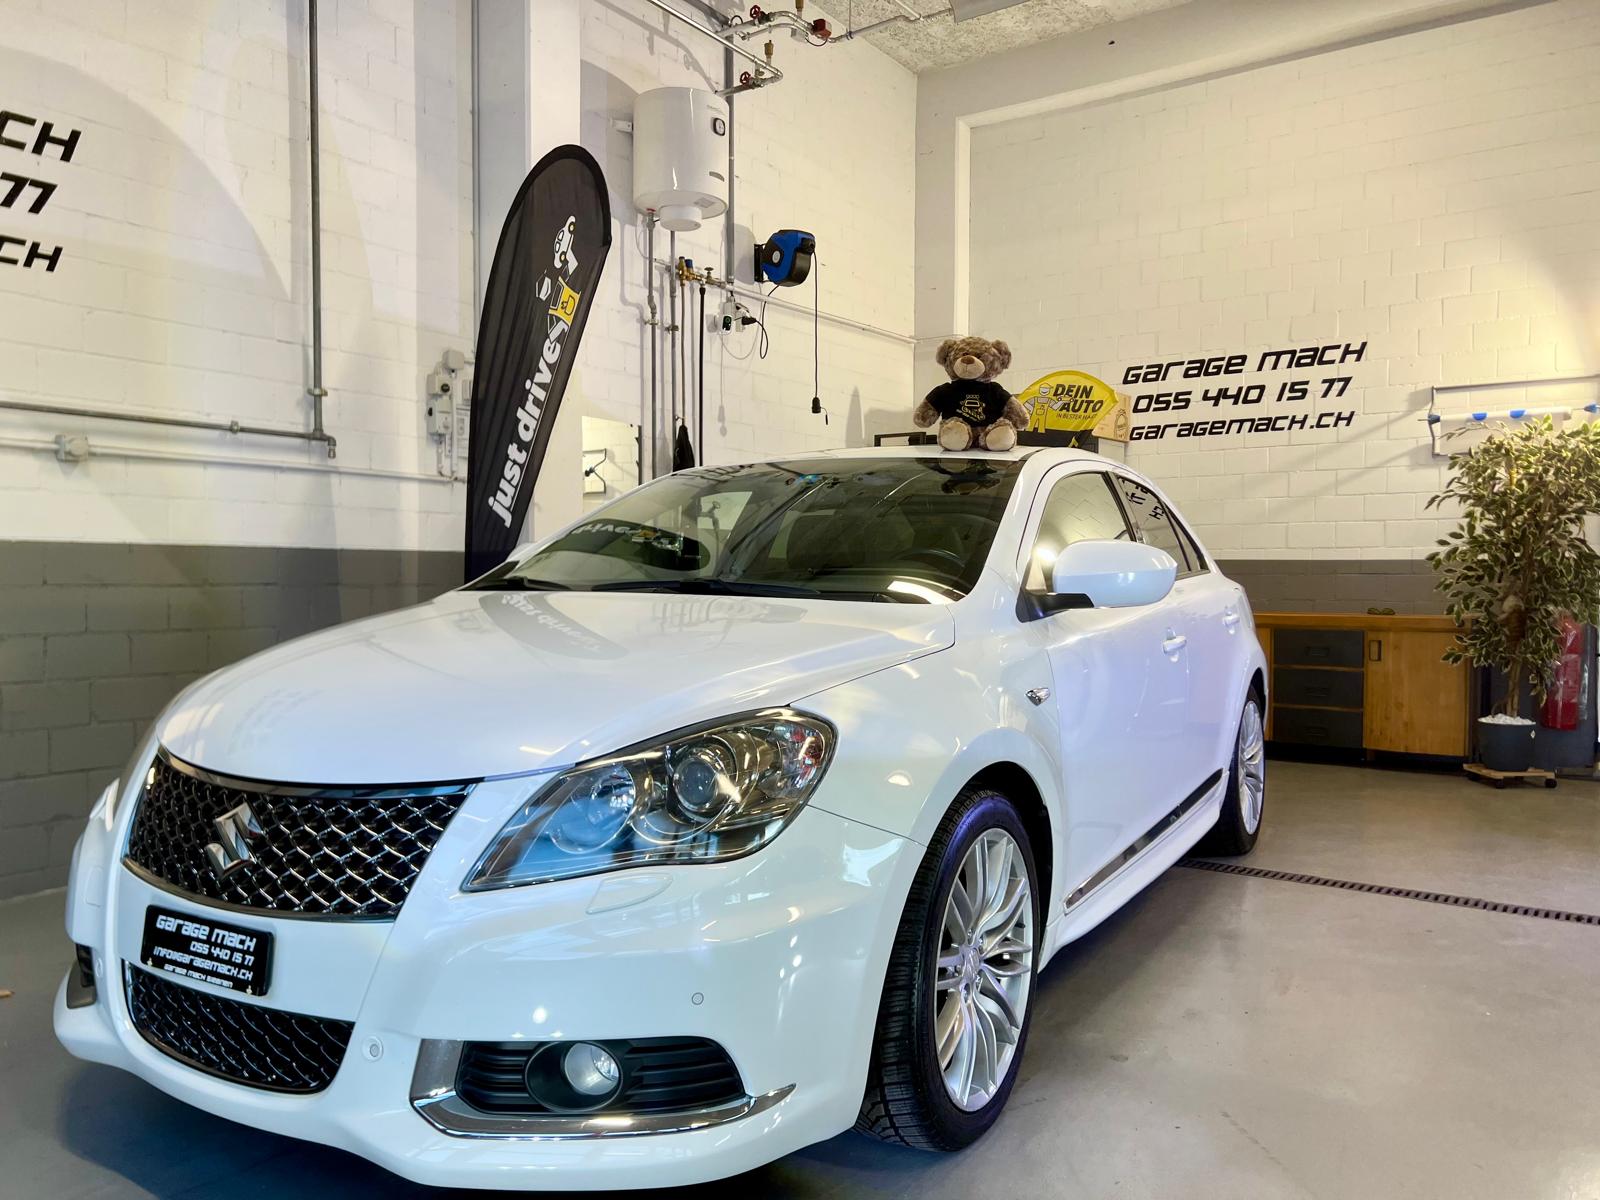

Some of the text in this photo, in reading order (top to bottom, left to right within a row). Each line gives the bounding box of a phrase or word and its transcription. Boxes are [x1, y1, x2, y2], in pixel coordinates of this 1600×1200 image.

[0, 172, 58, 215] 77
[1053, 383, 1094, 399] DEIN
[1059, 399, 1104, 413] AUTO
[1132, 376, 1354, 414] 055 440 15 77
[488, 337, 561, 529] just drive
[190, 940, 210, 955] 055
[211, 945, 231, 960] 440
[244, 955, 255, 967] 77
